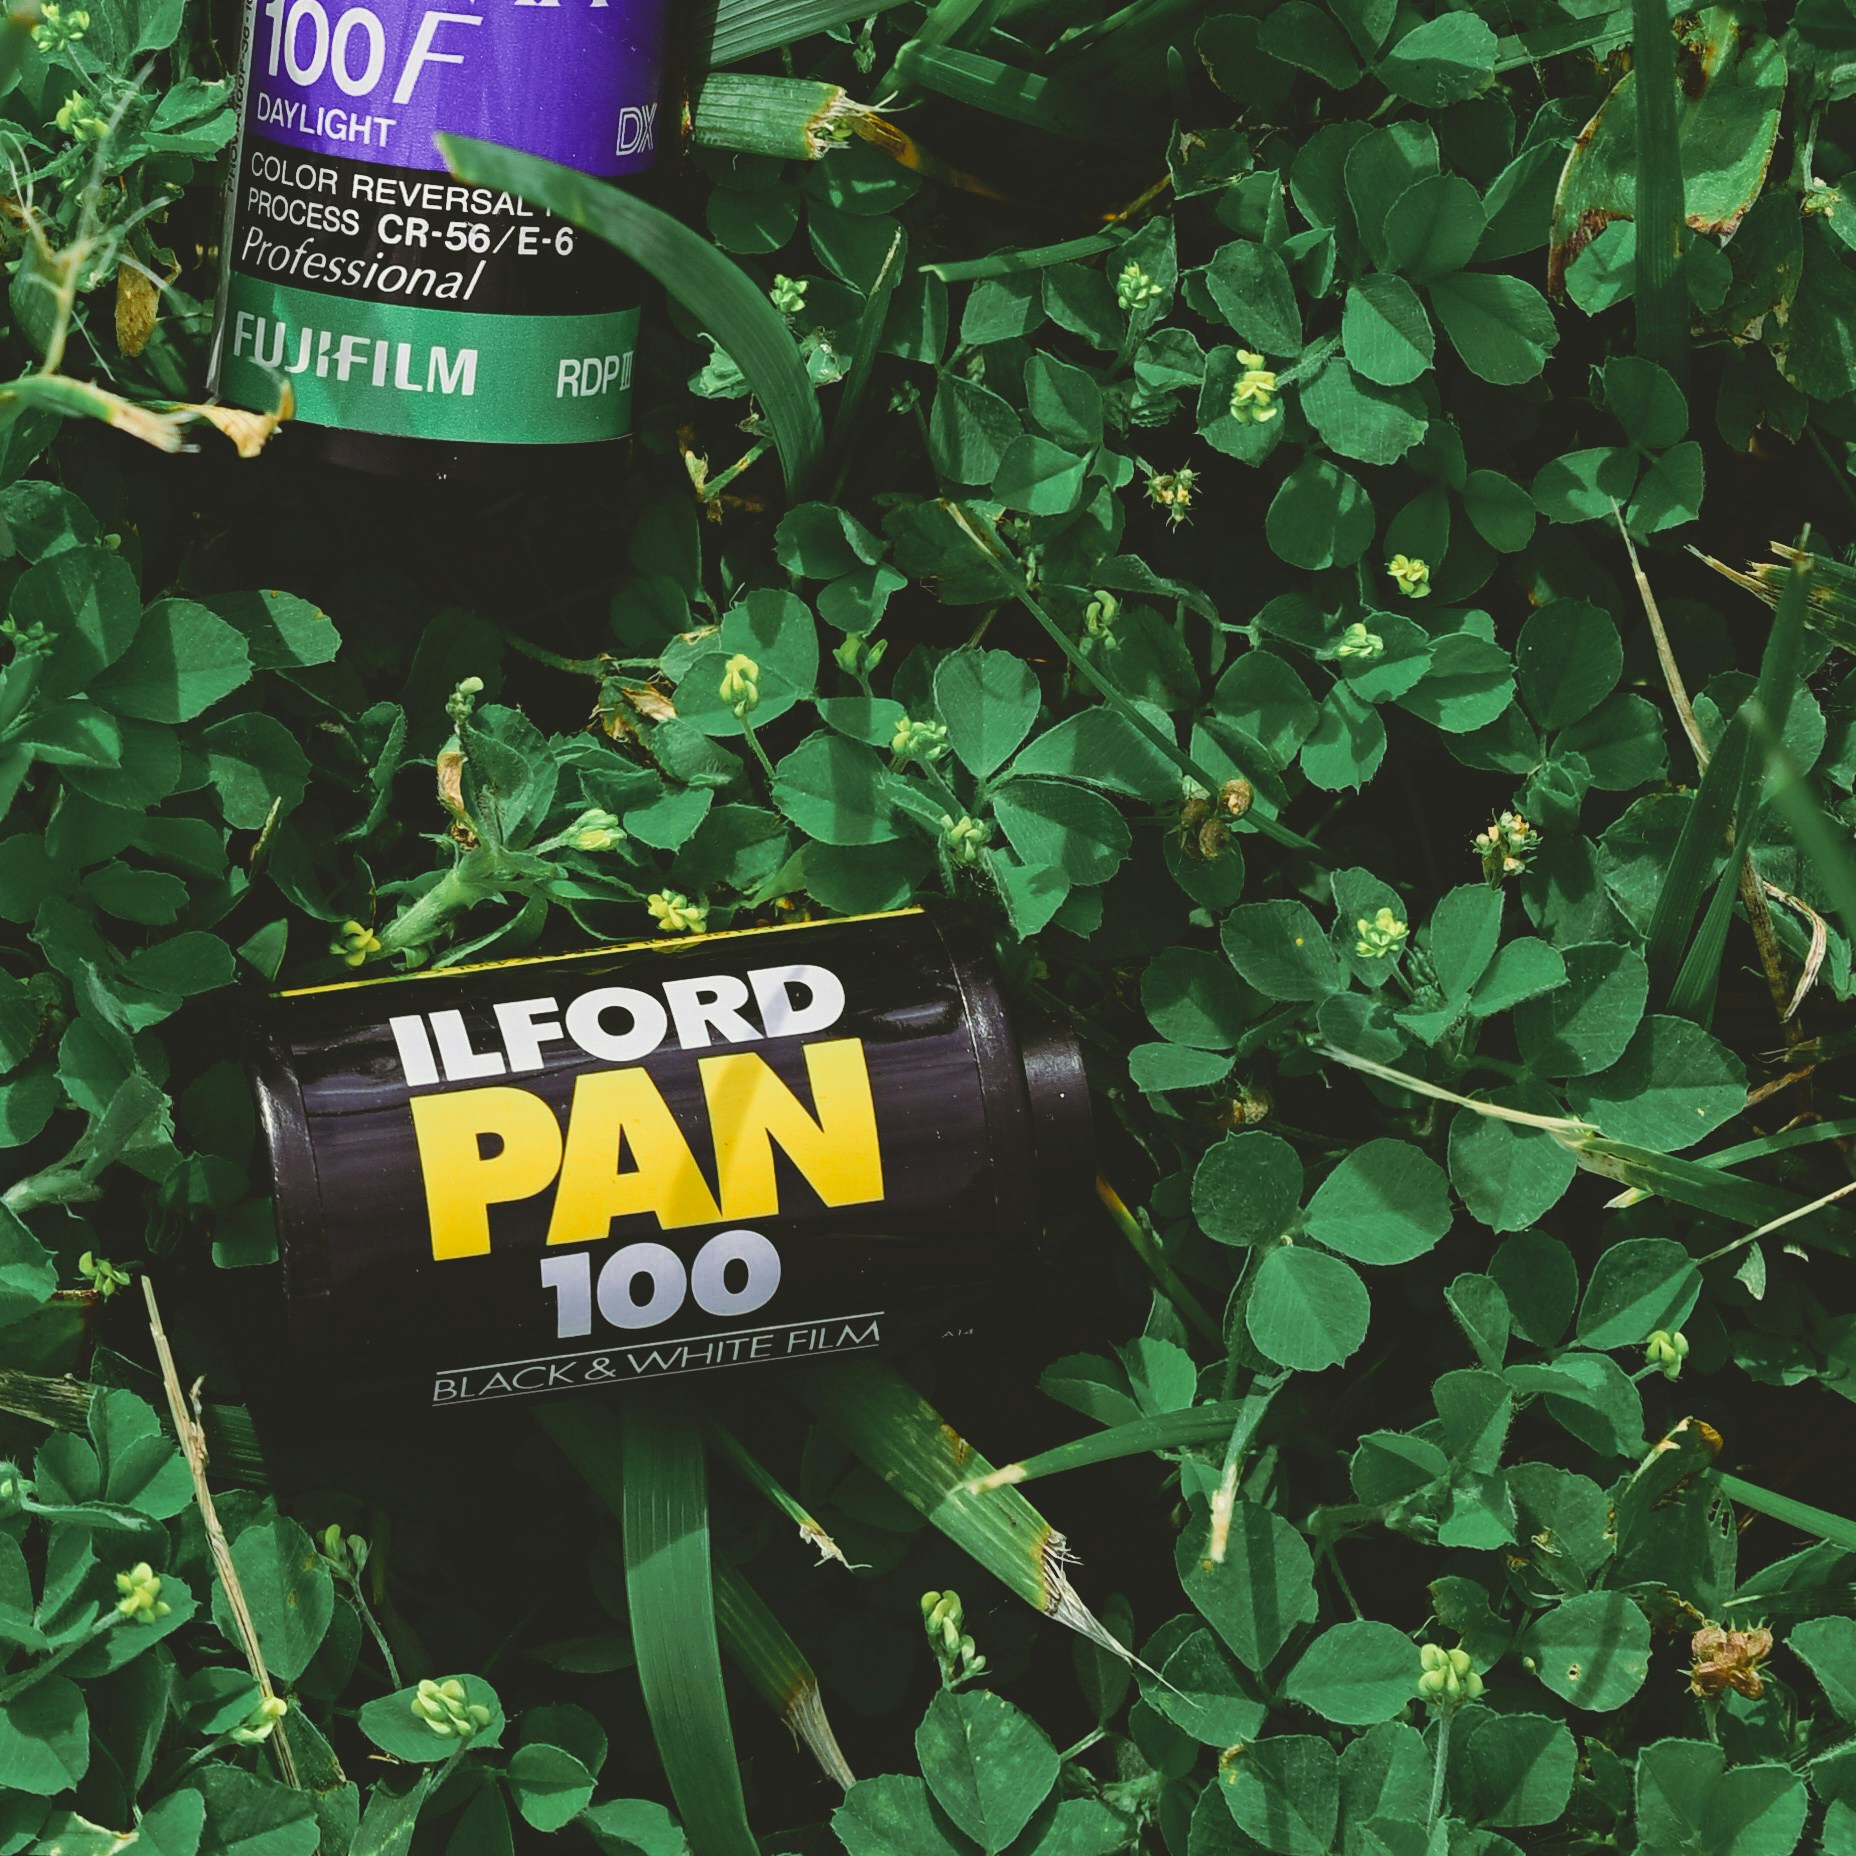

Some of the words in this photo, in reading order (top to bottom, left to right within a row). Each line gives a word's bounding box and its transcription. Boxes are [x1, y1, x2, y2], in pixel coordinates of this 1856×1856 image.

[258, 91, 396, 149] DAYLIGHT
[616, 102, 657, 156] DX
[248, 187, 359, 235] PROCESS
[251, 151, 337, 194] COLOR
[352, 174, 533, 217] REVERSAL
[242, 226, 486, 300] Professional
[233, 310, 478, 395] FUJIFILM
[389, 964, 845, 1087] ILFORD
[409, 1038, 884, 1261] PAN
[541, 1230, 781, 1339] 100
[433, 1361, 574, 1403] BLACK
[583, 1356, 617, 1381] &
[627, 1334, 774, 1373] WHITE
[786, 1320, 880, 1349] FILM
